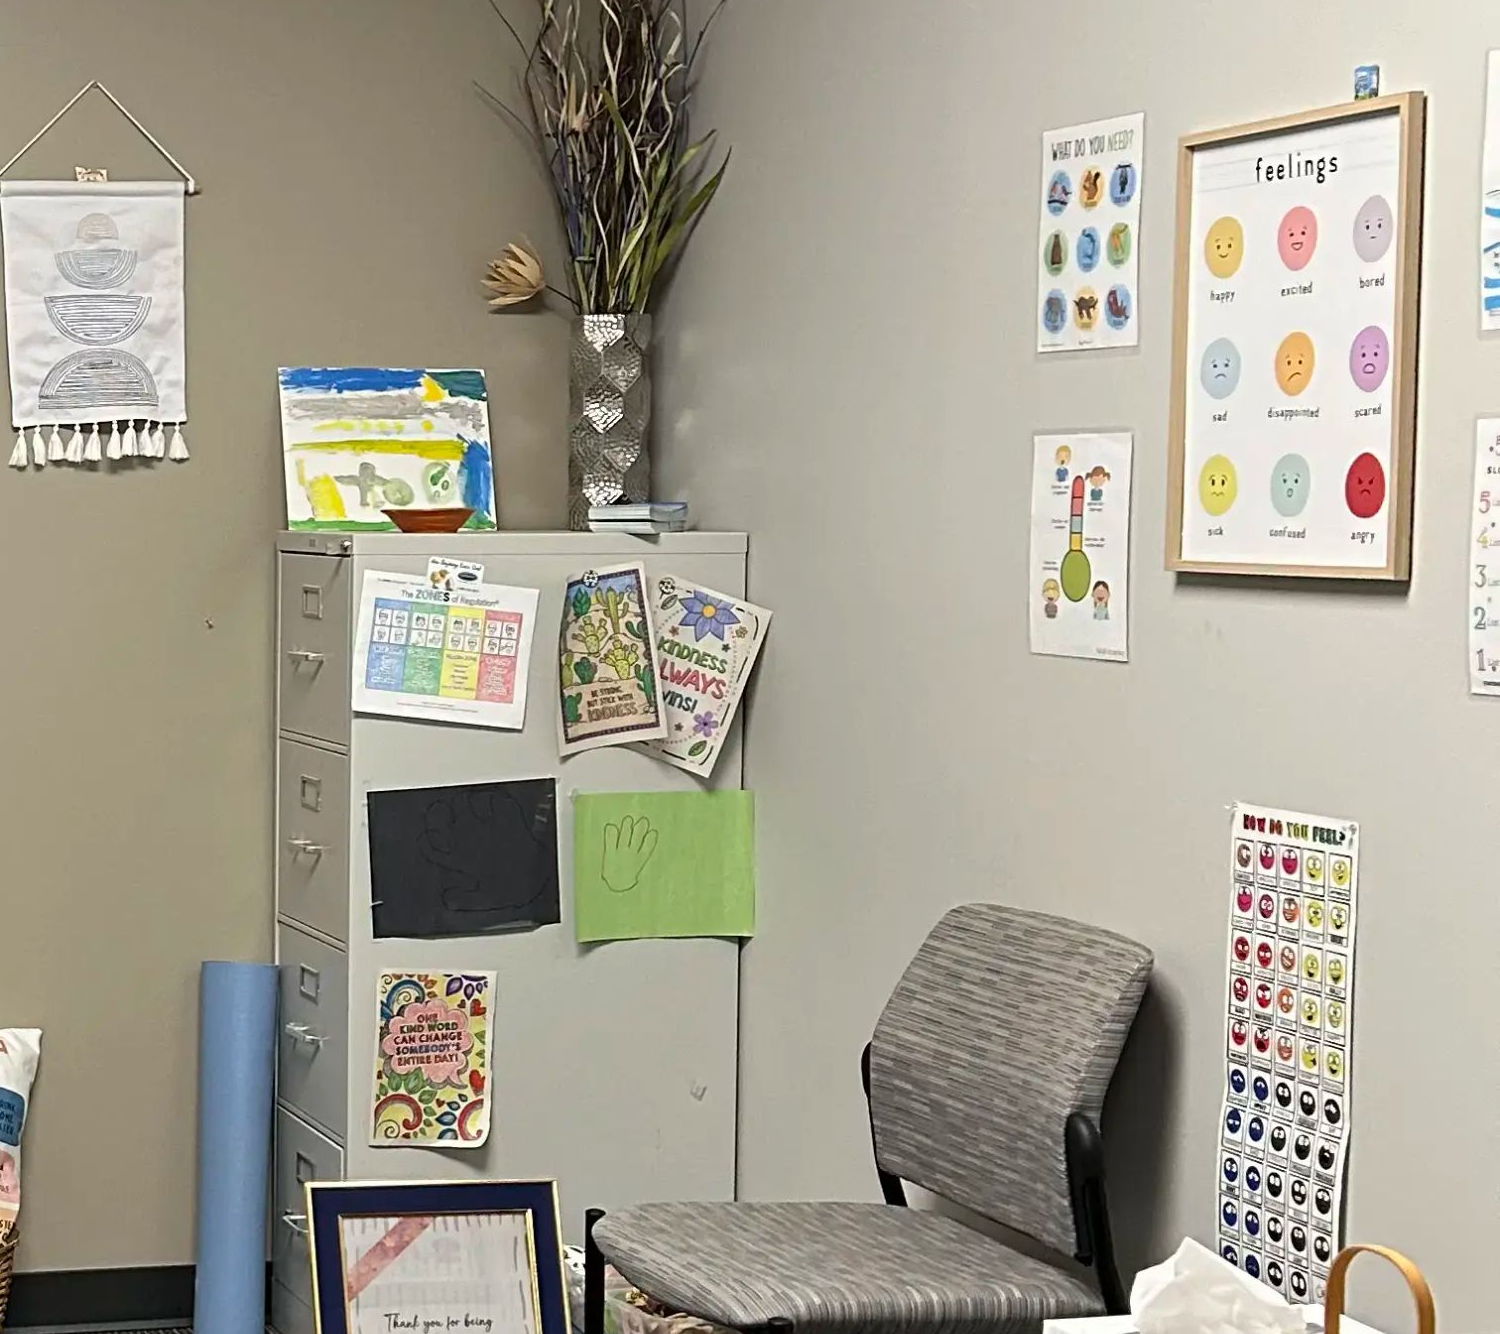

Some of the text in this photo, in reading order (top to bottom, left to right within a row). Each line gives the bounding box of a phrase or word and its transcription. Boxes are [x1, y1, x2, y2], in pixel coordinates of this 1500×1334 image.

[1051, 129, 1135, 161] WHAT DO YOU NEED?
[1255, 152, 1338, 184] feelings
[1359, 273, 1386, 289] bored
[1280, 281, 1313, 297] excited
[1209, 290, 1235, 304] happy
[1212, 411, 1228, 422] sad
[1267, 407, 1320, 422] disappointed
[1354, 403, 1382, 418] scared
[1478, 491, 1492, 514] 5
[1207, 525, 1224, 537] sick
[1269, 525, 1307, 539] confused
[1350, 530, 1376, 544] angry
[1474, 564, 1487, 589] 3
[401, 589, 414, 599] The
[415, 589, 451, 603] ZONES
[451, 595, 459, 603] of
[1474, 606, 1487, 630] 2
[1477, 648, 1487, 672] 1
[659, 658, 727, 700] LWAYS
[587, 693, 633, 708] BUT STICK WITH
[587, 702, 639, 722] KINDNESS
[1243, 813, 1346, 846] HOW DO YOU FEEL?
[417, 1013, 438, 1023] ONE
[400, 1022, 458, 1034] KIND WORD
[393, 1032, 463, 1045] CAN CHANGE
[395, 1042, 461, 1055] SOMEBODY'S
[397, 1053, 458, 1066] ENTIRE DAY!
[383, 1312, 493, 1334] Thank you for being
